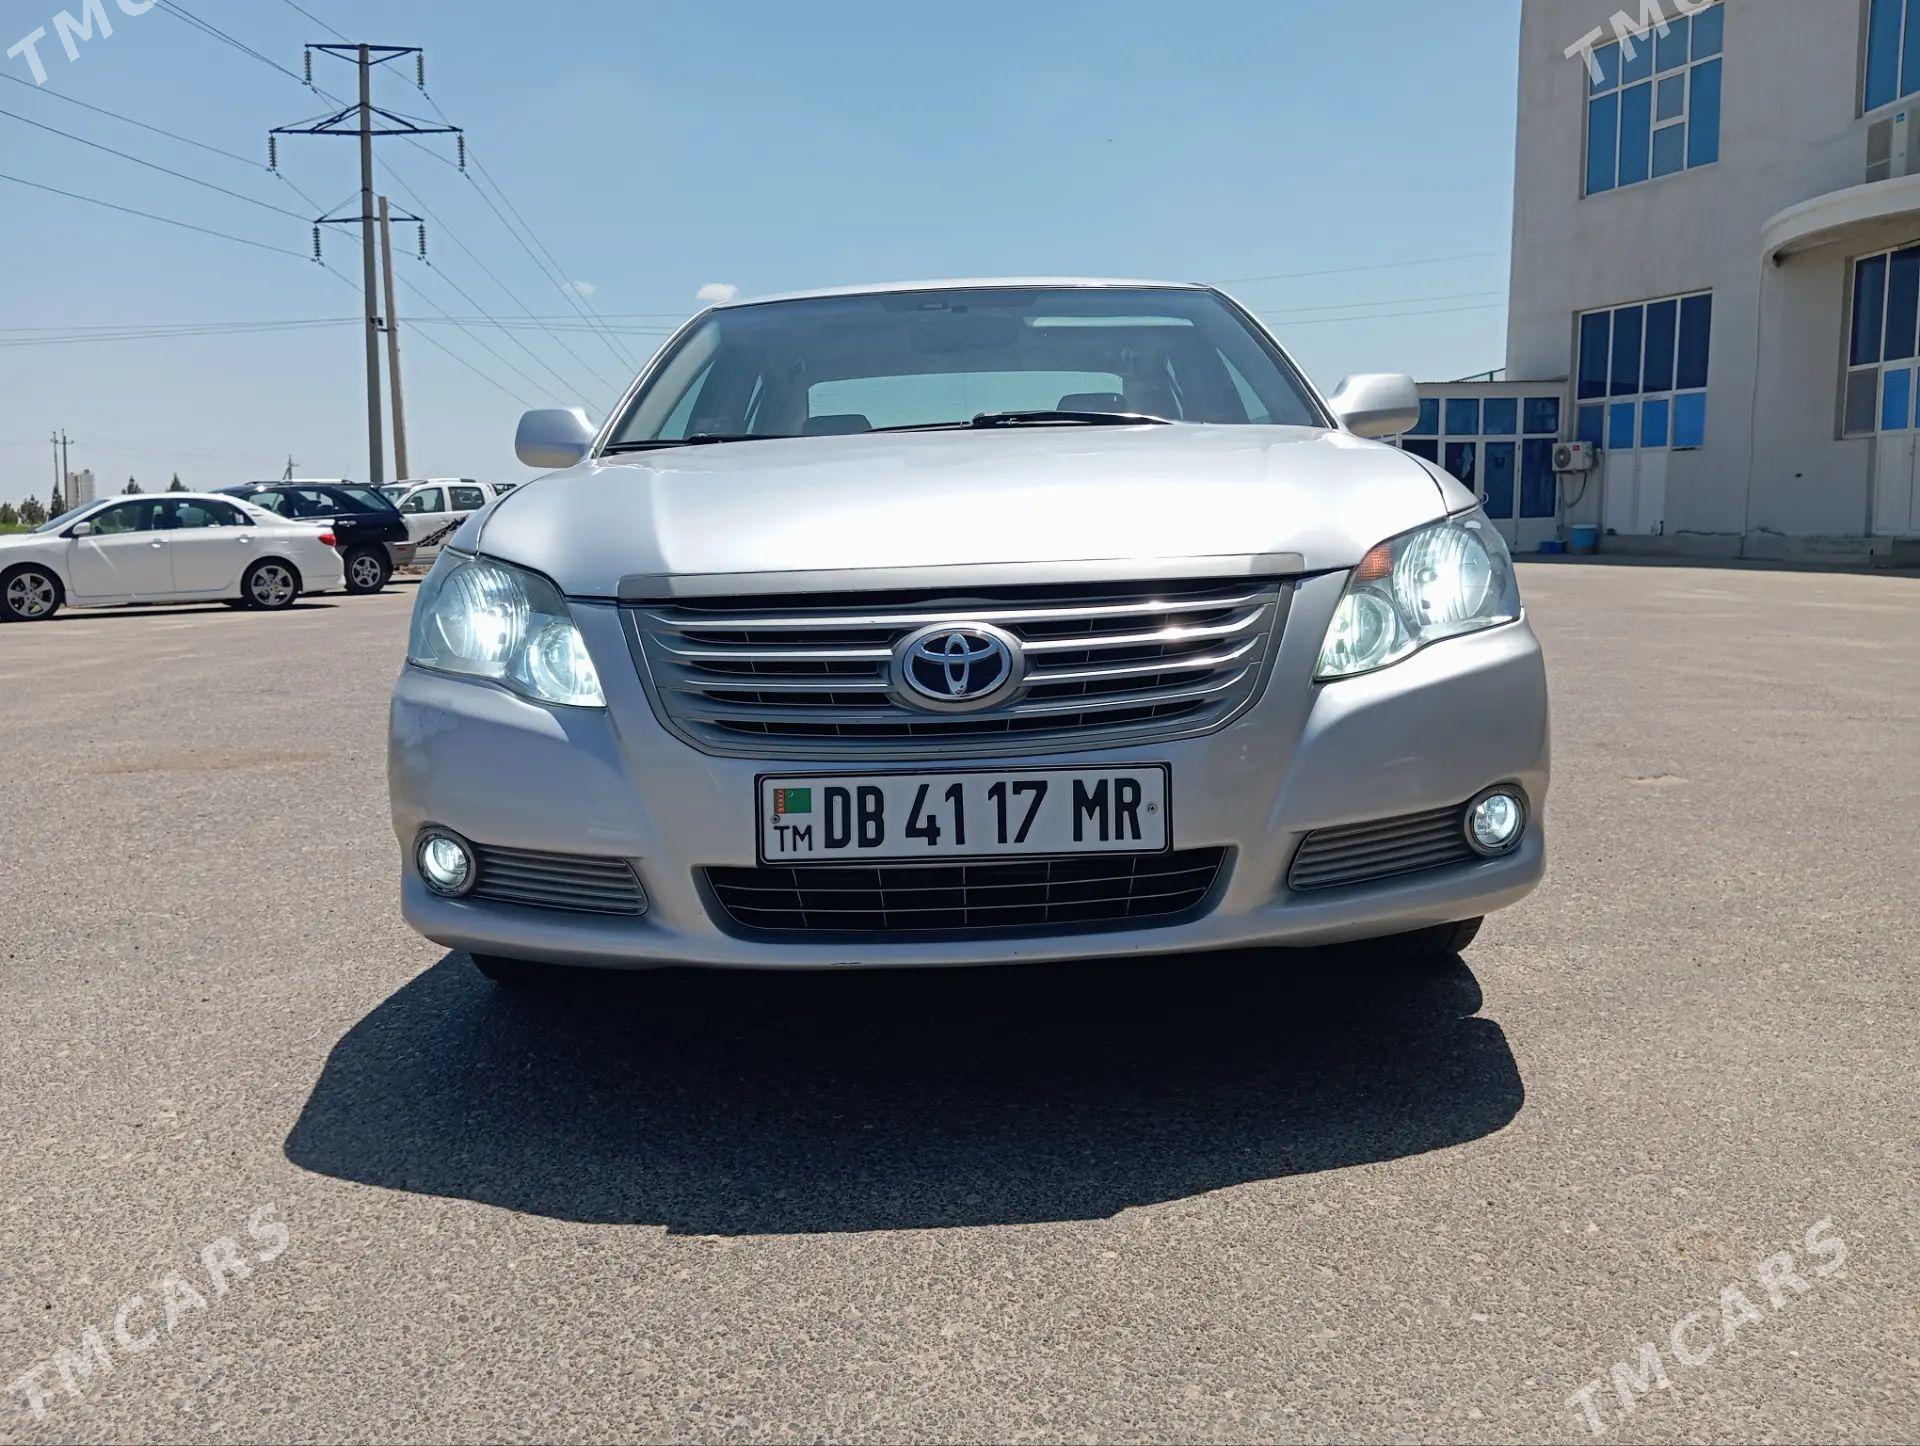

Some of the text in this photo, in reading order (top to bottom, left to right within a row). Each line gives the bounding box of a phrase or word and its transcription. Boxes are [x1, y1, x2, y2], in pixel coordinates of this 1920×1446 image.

[823, 778, 1142, 849] DB 41 17 MR
[773, 825, 813, 852] TM
